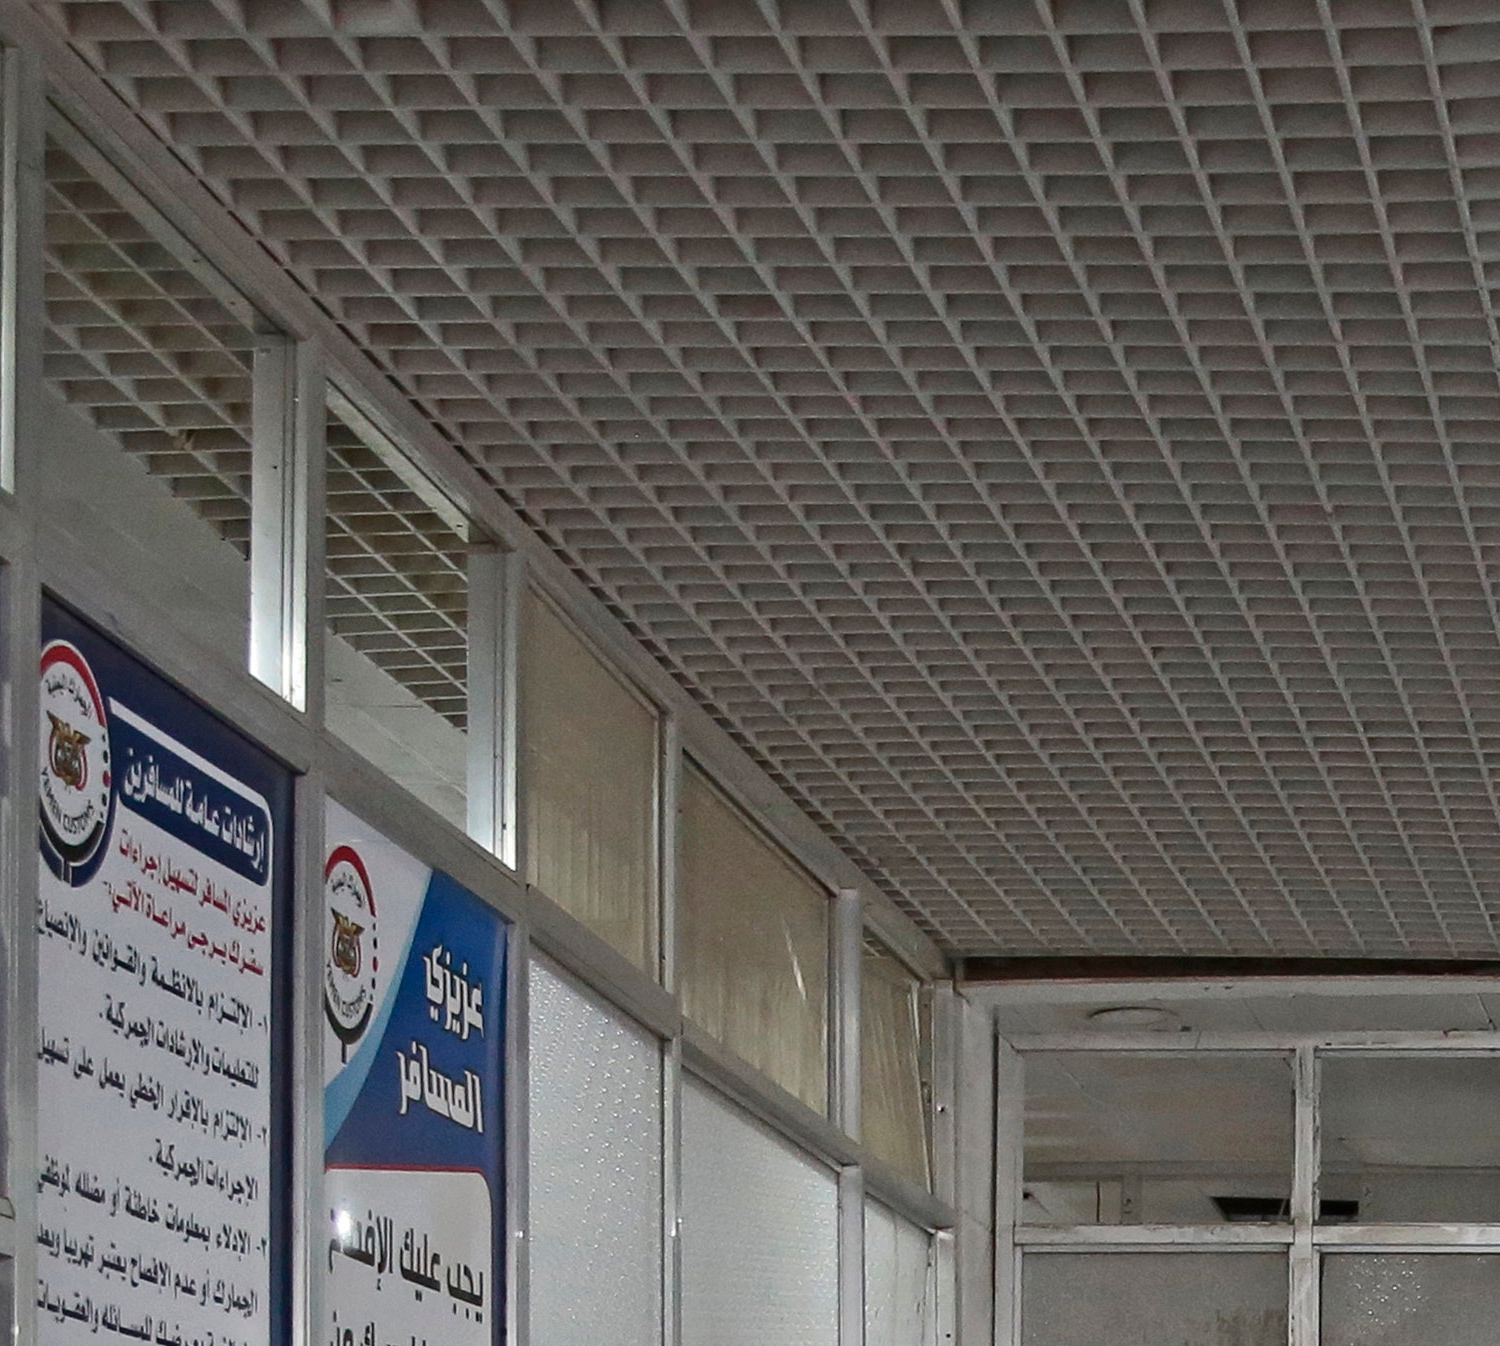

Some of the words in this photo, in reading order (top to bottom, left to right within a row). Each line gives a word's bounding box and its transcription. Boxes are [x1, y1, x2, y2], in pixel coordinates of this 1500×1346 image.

[123, 747, 185, 814] للمسافرين
[184, 779, 220, 837] عامة
[118, 828, 162, 885] إجراءات
[222, 805, 265, 873] إرشادات
[162, 857, 198, 896] لتسهيل
[198, 877, 231, 915] المسافر
[145, 892, 186, 940] مراعاة
[232, 898, 266, 935] عزيزي
[187, 932, 227, 966] يرجى
[228, 939, 264, 977] سفرك
[423, 944, 485, 1038] عزيزي
[211, 1046, 260, 1090] للتعليمات
[395, 1041, 484, 1134] المسافر
[399, 1227, 441, 1303] عليك
[446, 1262, 484, 1325] يجب
